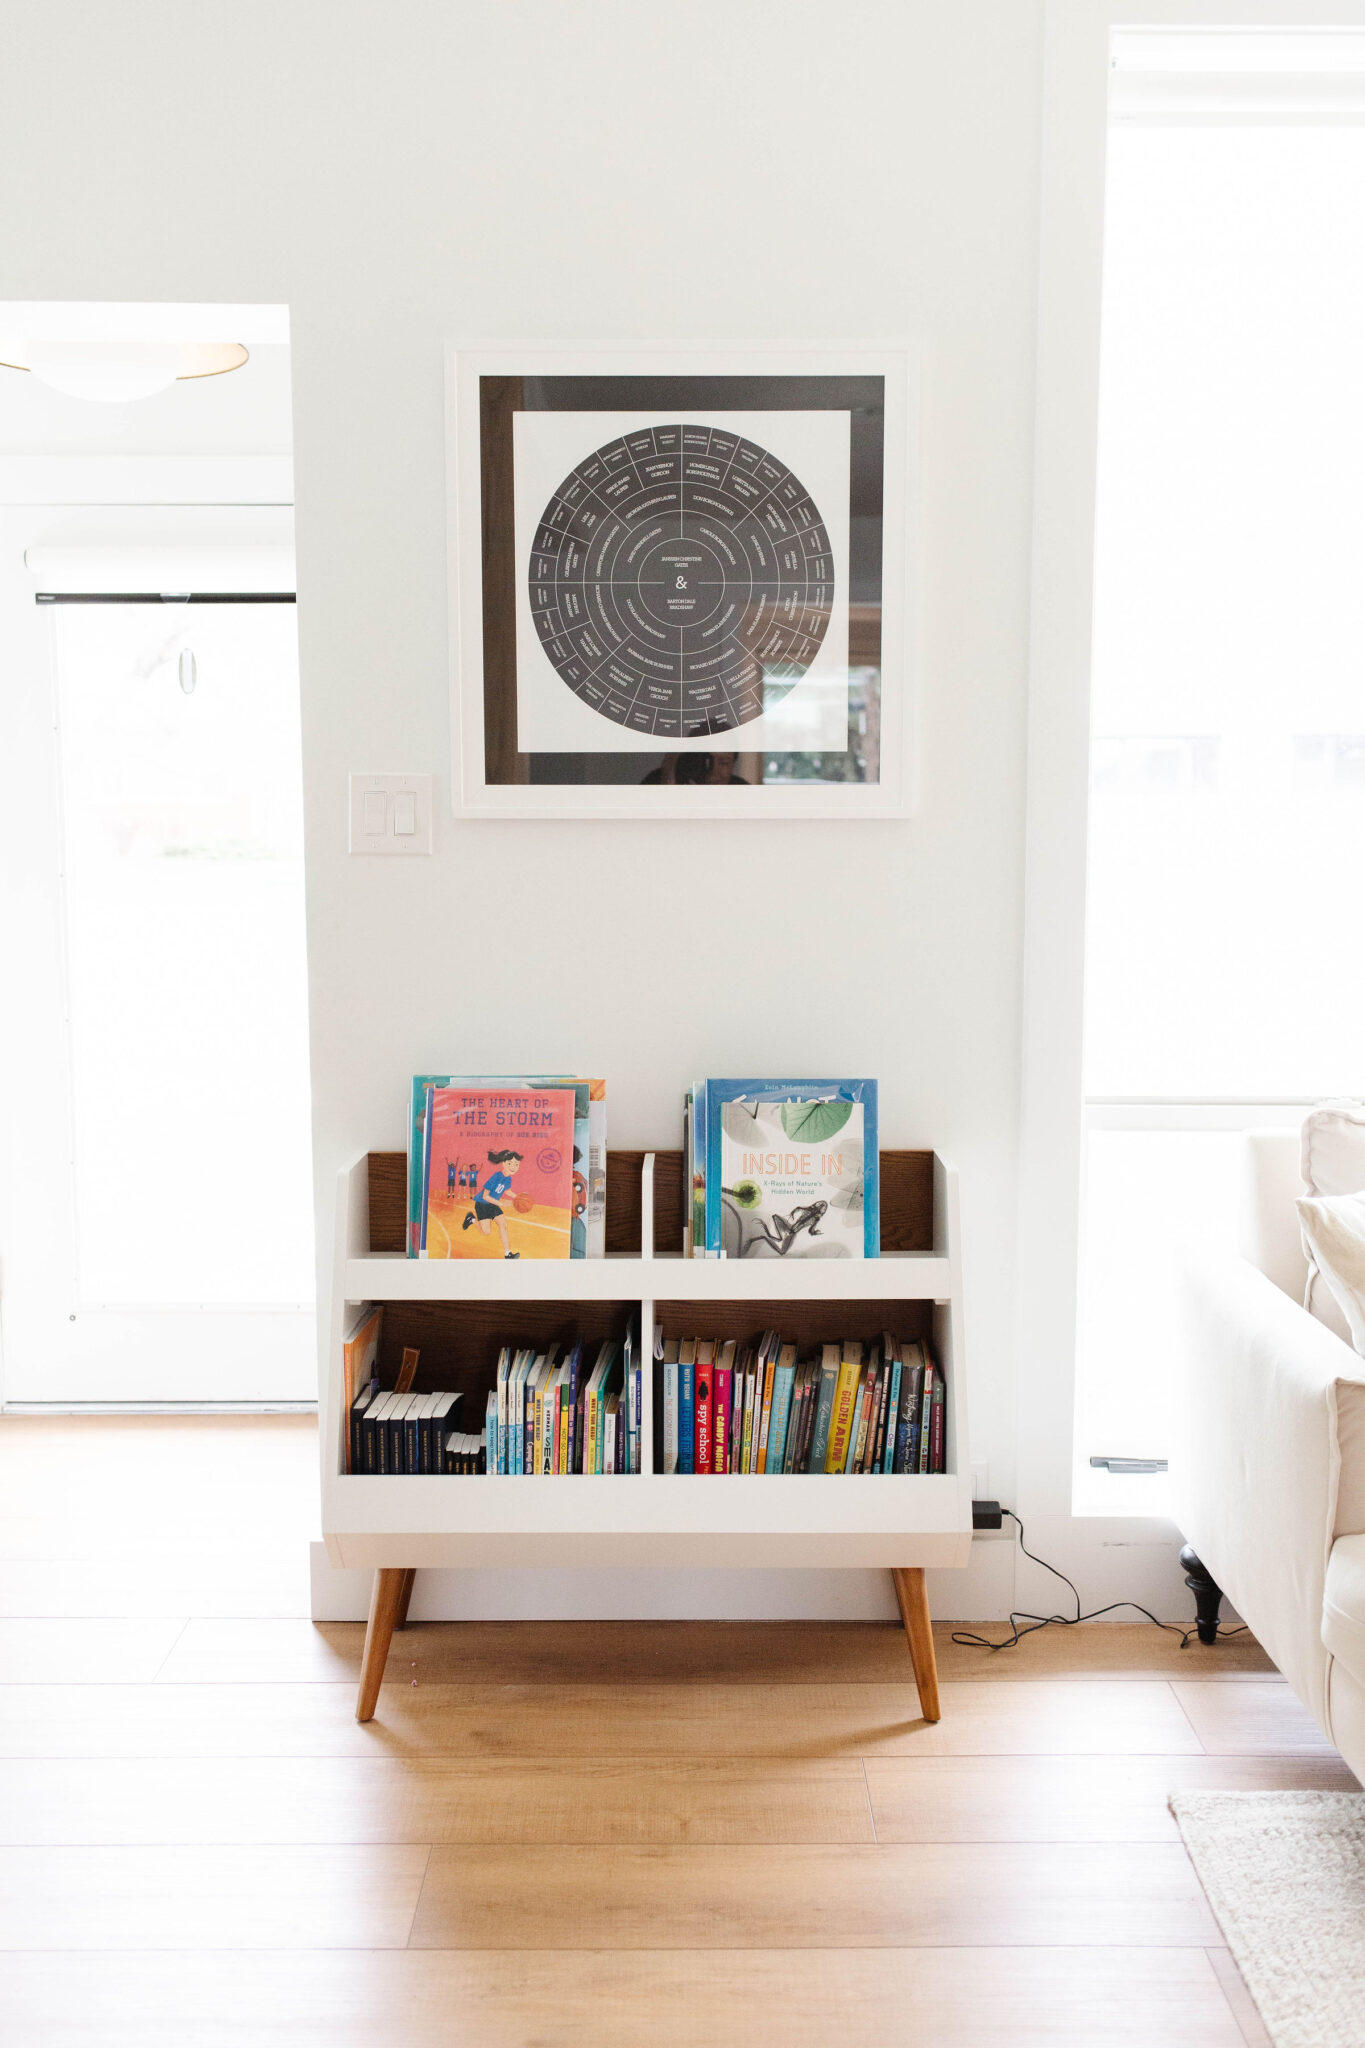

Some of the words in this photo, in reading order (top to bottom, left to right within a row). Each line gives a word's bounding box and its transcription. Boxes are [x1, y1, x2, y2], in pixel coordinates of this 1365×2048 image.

[676, 576, 687, 589] &
[462, 1098, 484, 1108] THE
[490, 1098, 528, 1108] HEART
[535, 1099, 550, 1108] OF
[454, 1112, 487, 1125] THE
[496, 1112, 553, 1126] STORM
[742, 1154, 811, 1175] INSIDE
[821, 1154, 842, 1175] IN
[494, 1184, 504, 1194] 10
[698, 1405, 707, 1425] spy
[838, 1391, 852, 1425] GOLDEN
[902, 1394, 918, 1423] Wishing
[681, 1406, 690, 1437] LETTERS
[716, 1416, 724, 1443] CANDY
[700, 1428, 709, 1464] school
[832, 1426, 846, 1462] ARM
[715, 1446, 724, 1472] MAFIA
